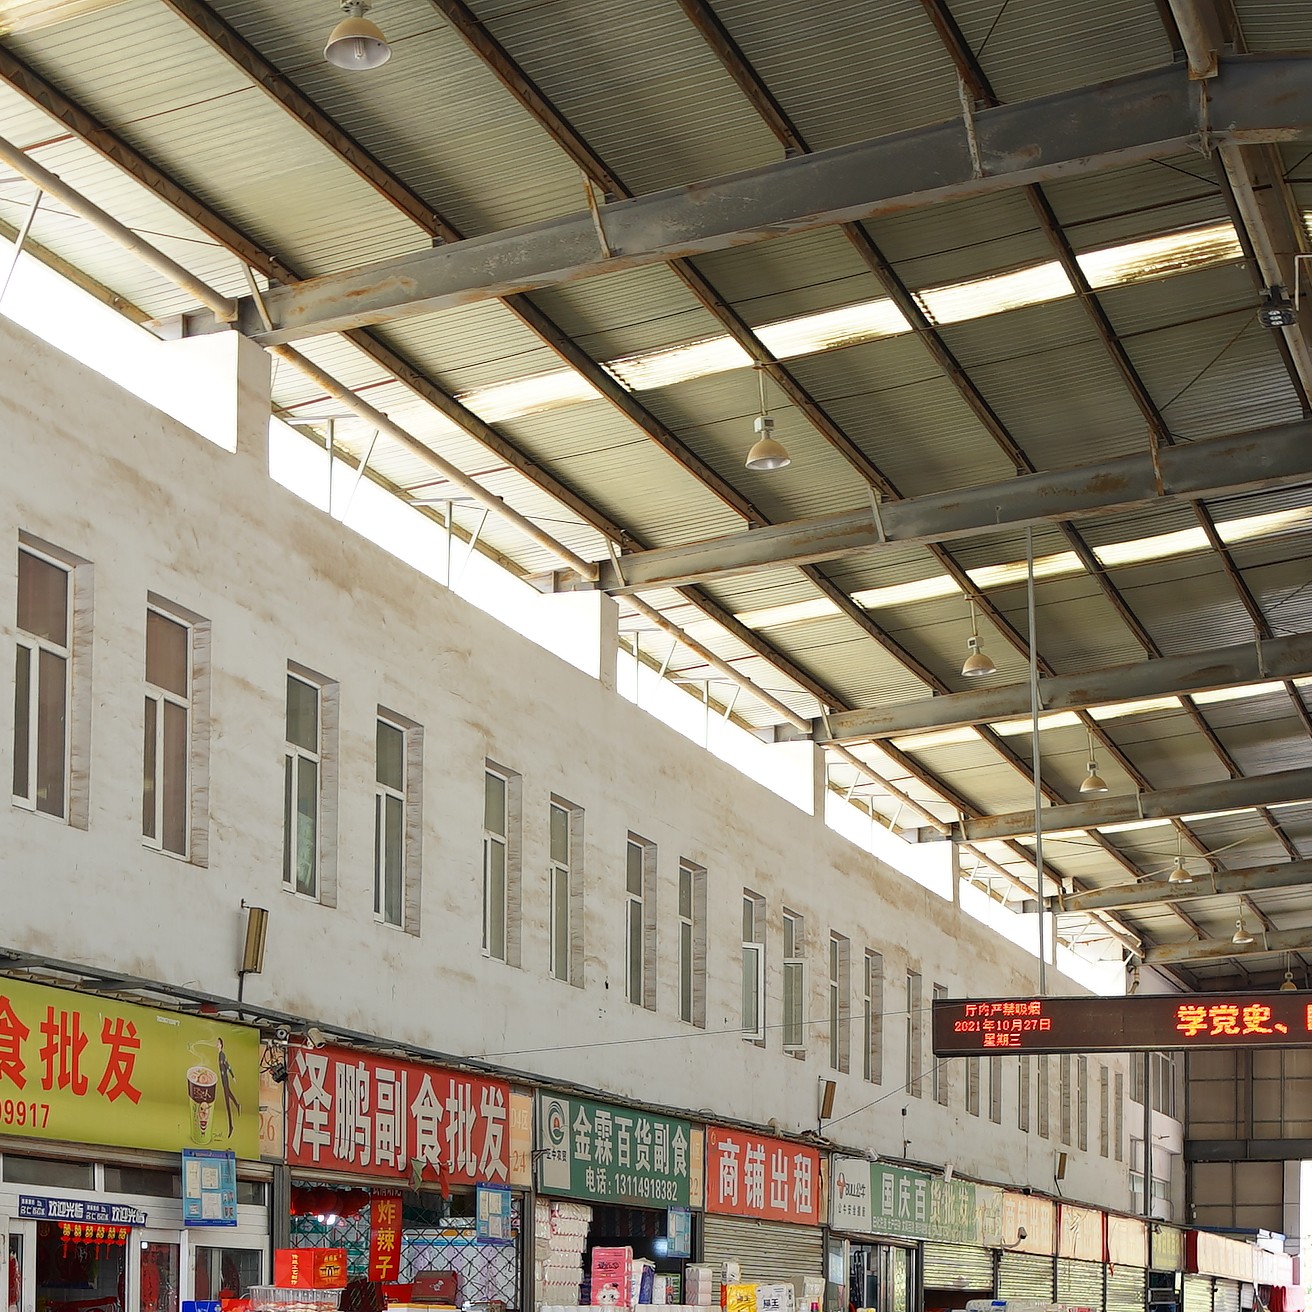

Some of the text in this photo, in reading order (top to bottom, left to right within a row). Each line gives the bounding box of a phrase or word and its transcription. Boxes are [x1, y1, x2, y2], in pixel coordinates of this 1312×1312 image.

[954, 1018, 1051, 1031] 2021年10月27日
[965, 1002, 1041, 1017] 厅内严禁吸烟
[983, 1033, 1021, 1047] 星期三
[292, 1049, 508, 1182] 泽鹏副食批发
[512, 1150, 527, 1173] 24
[572, 1105, 688, 1178] 金霖百货副食
[718, 1138, 814, 1214] 商铺出租
[376, 1200, 396, 1280] 炸辣子
